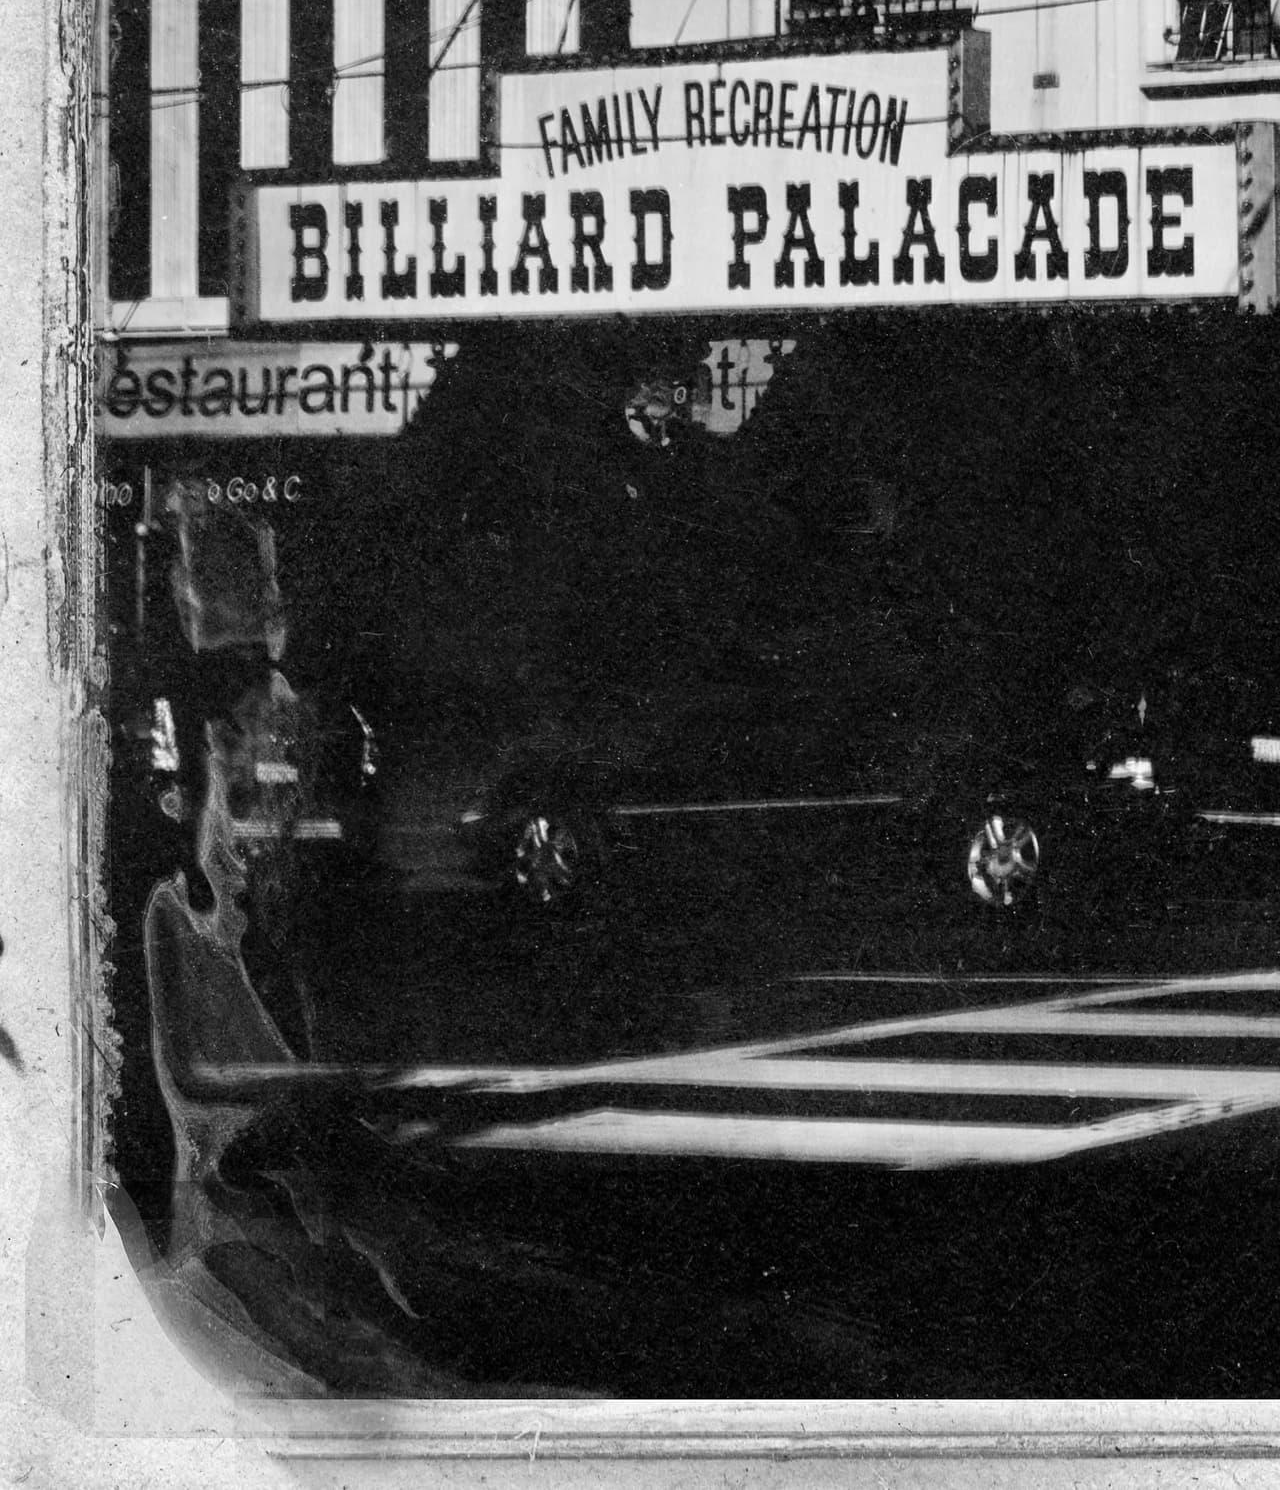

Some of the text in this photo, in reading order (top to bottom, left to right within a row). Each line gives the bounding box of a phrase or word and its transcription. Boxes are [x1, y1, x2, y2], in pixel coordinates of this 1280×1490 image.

[537, 78, 908, 179] FAMILY RECREATION
[289, 166, 1195, 302] BILLIARD PALACADE
[101, 348, 399, 418] estaurant
